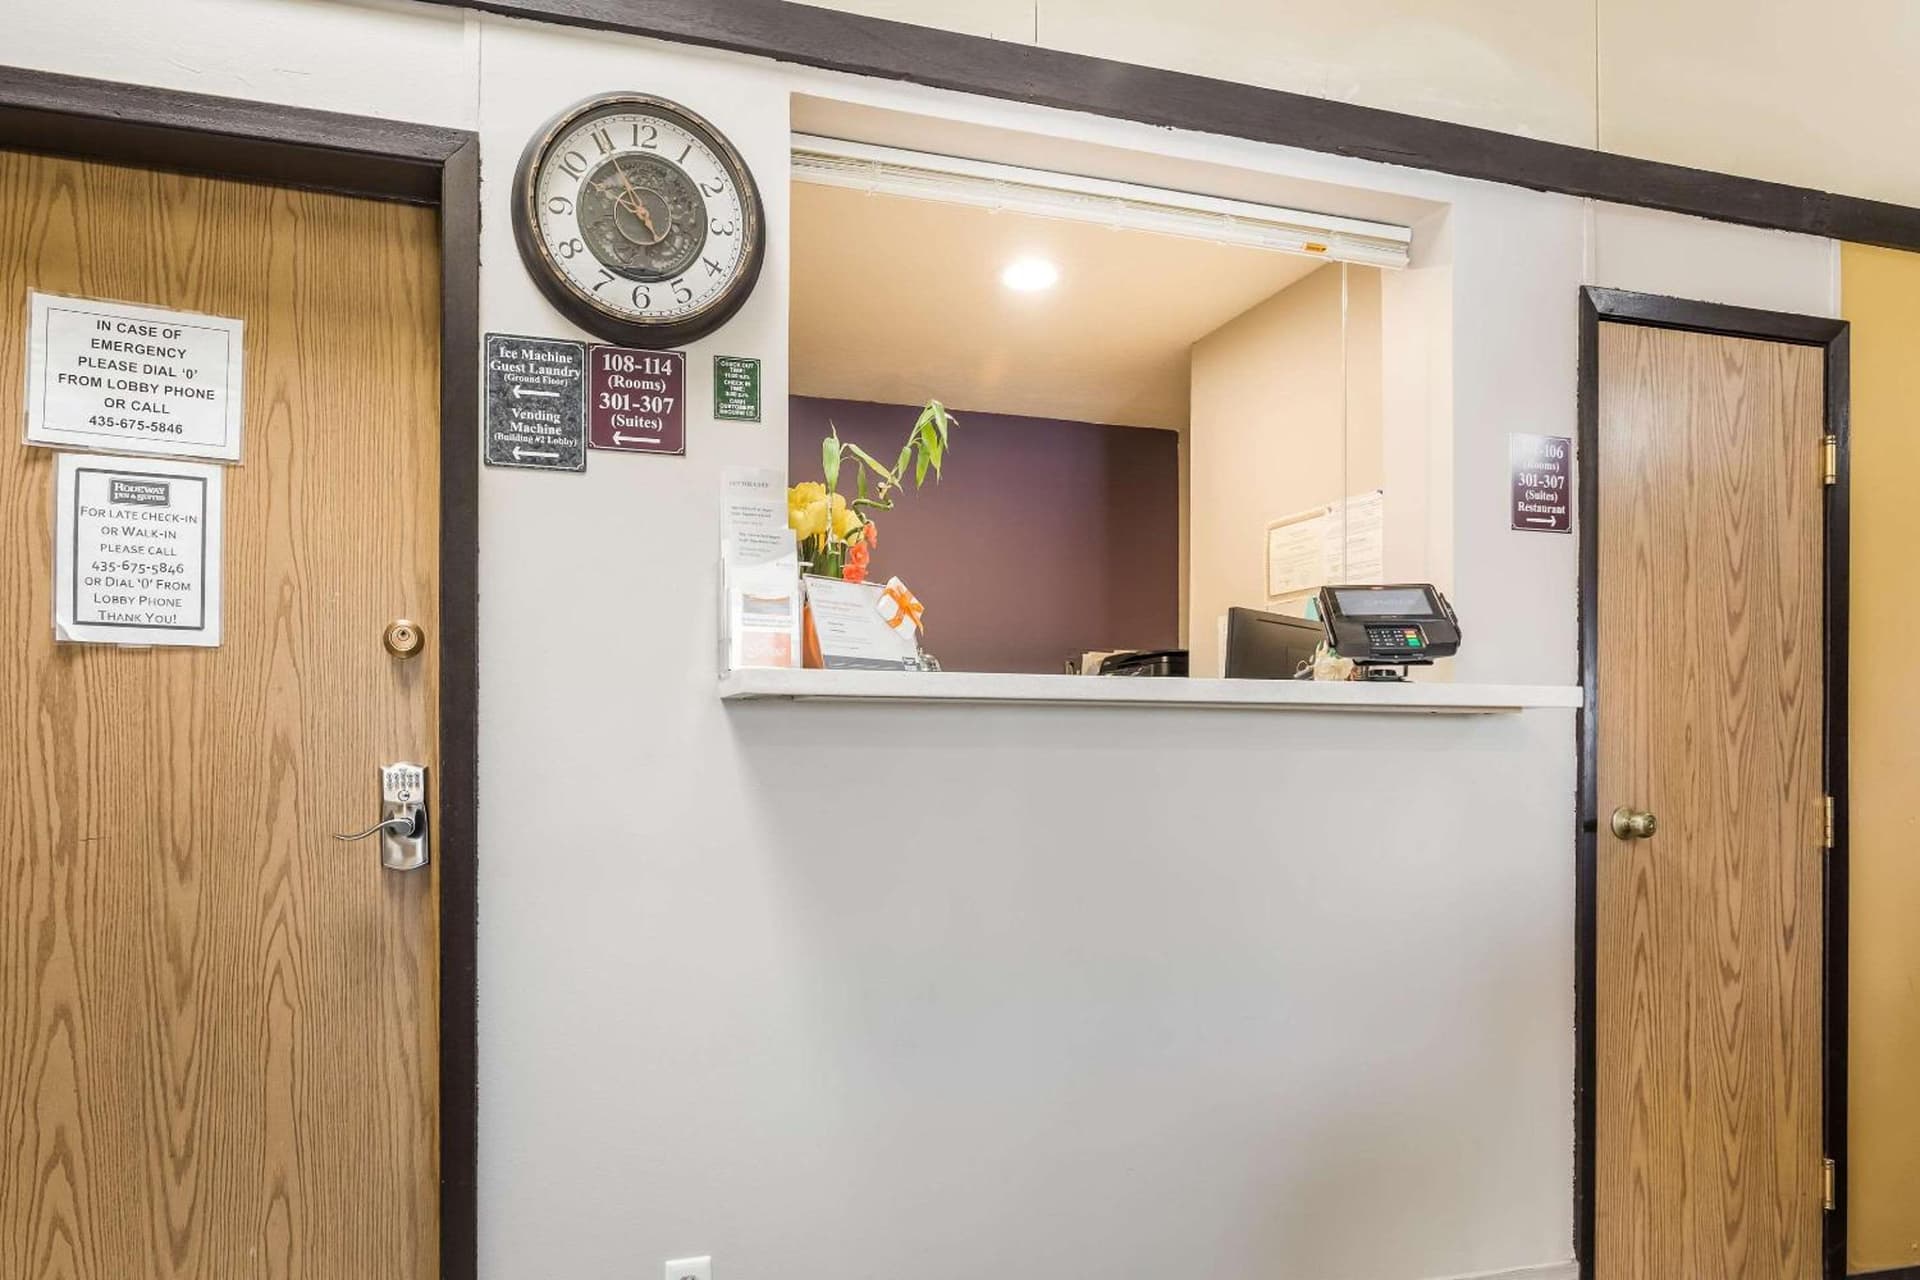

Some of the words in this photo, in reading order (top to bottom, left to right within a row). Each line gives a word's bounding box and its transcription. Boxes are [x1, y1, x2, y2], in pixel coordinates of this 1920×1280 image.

[591, 127, 616, 154] 11
[631, 123, 658, 149] 12
[676, 145, 692, 165] 1
[559, 150, 588, 182] 10
[700, 176, 724, 198] 2
[549, 196, 573, 216] 9
[710, 218, 734, 237] 3
[559, 238, 584, 259] 8
[701, 255, 723, 278] 4
[591, 269, 616, 293] 7
[632, 285, 651, 310] 6
[671, 278, 692, 305] 5
[97, 320, 111, 331] IN
[117, 323, 157, 337] CASE
[162, 328, 182, 340] OF
[91, 338, 187, 359] EMERGENCY
[499, 347, 517, 358] Ice
[521, 349, 573, 363] Machine
[78, 356, 137, 373] PLEASE
[143, 364, 176, 377] DIAL
[490, 361, 525, 373] Guest
[529, 363, 580, 380] Laundry
[602, 354, 672, 376] 108-114
[58, 373, 102, 388] FROM
[107, 379, 159, 394] LOBBY
[164, 385, 215, 400] PHONE
[504, 374, 540, 383] (Ground
[542, 376, 568, 386] Floor)
[608, 374, 666, 393] (Rooms)
[104, 397, 126, 409] OR
[131, 401, 170, 414] CALL
[599, 392, 674, 414] 301-307
[89, 416, 183, 434] 435-675-5846
[512, 408, 561, 424] Vending
[611, 413, 663, 432] (Suites)
[510, 422, 562, 435] Machine
[547, 436, 577, 447] Lobby)
[1518, 472, 1565, 489] 301-307
[1525, 490, 1558, 503] (Suites)
[1518, 501, 1565, 514] Restaurant
[92, 560, 184, 575] 435-675-5846
